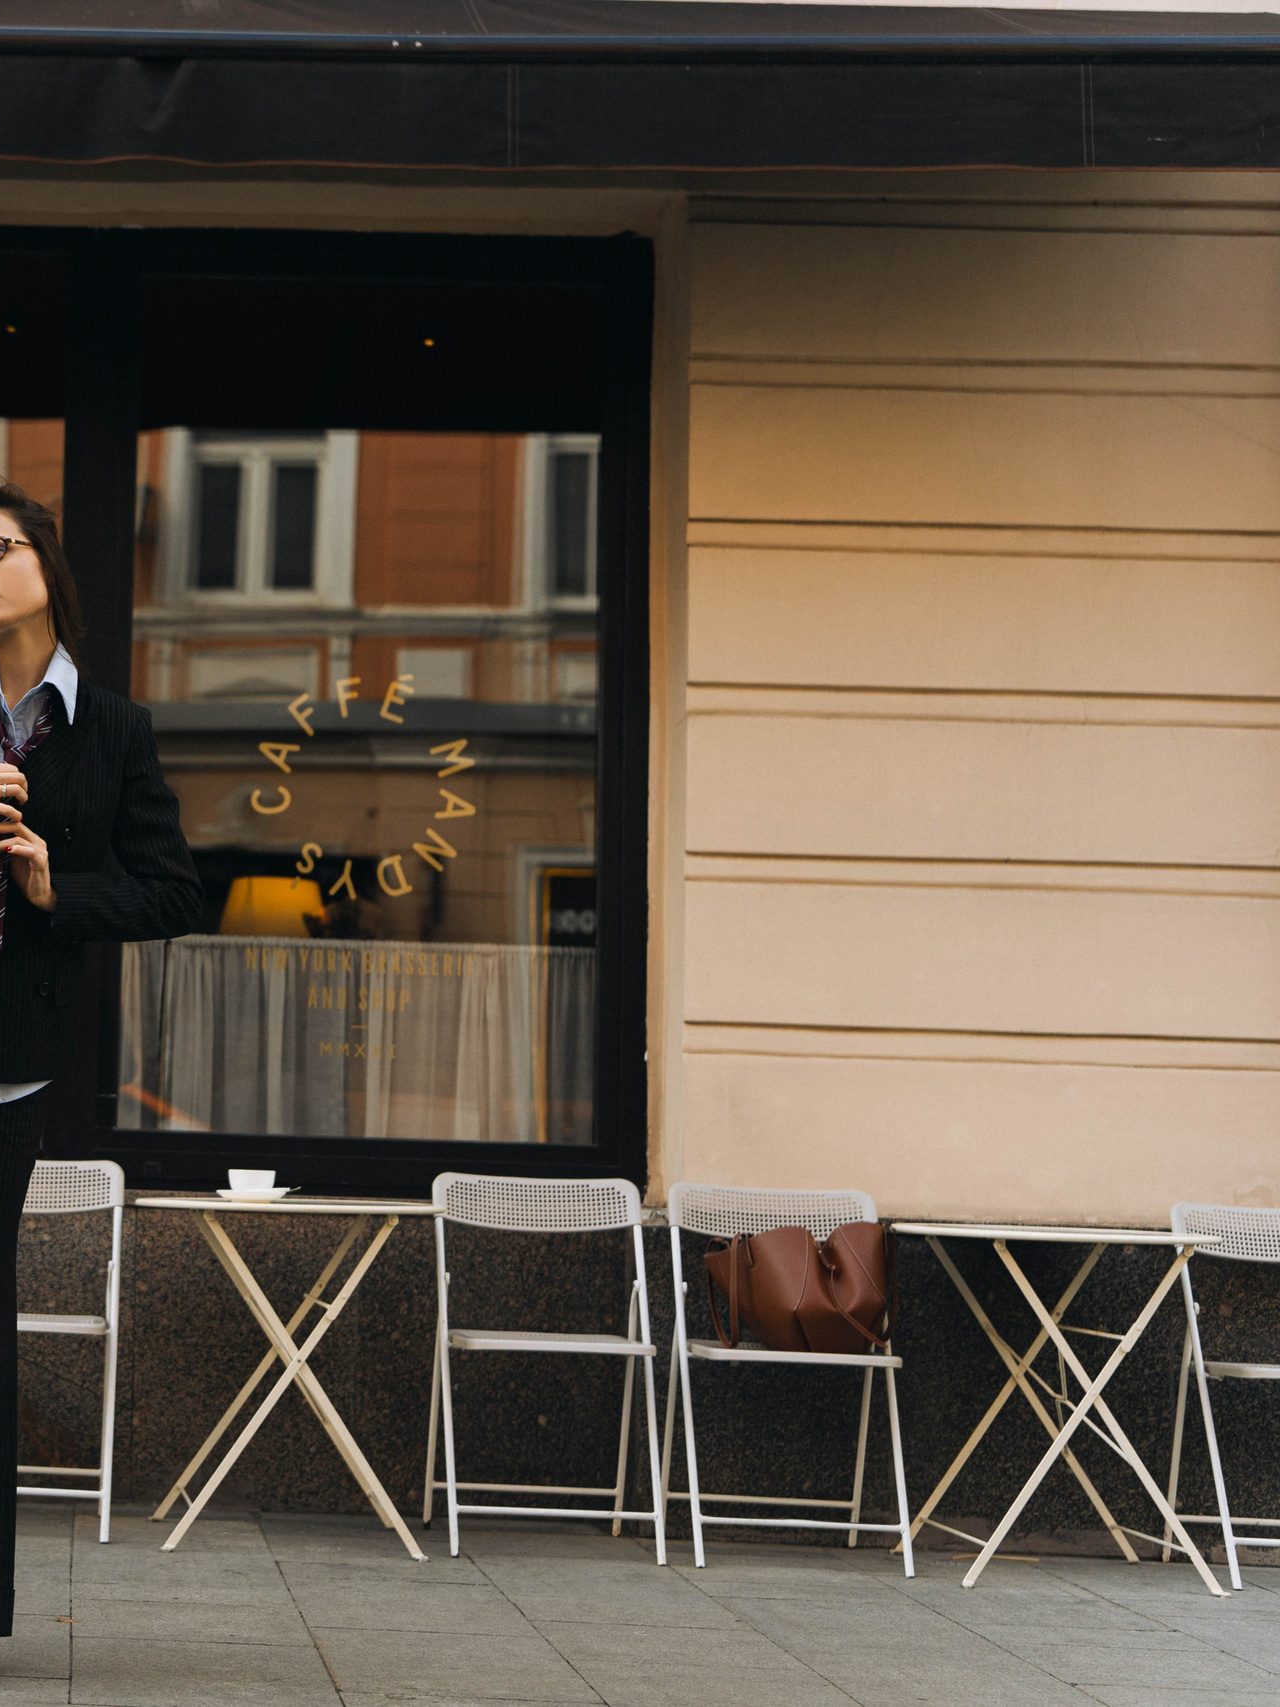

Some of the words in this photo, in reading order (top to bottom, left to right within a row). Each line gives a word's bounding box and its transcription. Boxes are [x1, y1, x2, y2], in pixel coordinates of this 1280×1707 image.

[251, 674, 415, 815] CAFFÉ
[246, 947, 289, 971] NEW
[300, 948, 353, 974] YORK
[307, 986, 347, 1011] AND
[359, 987, 411, 1013] SHOP
